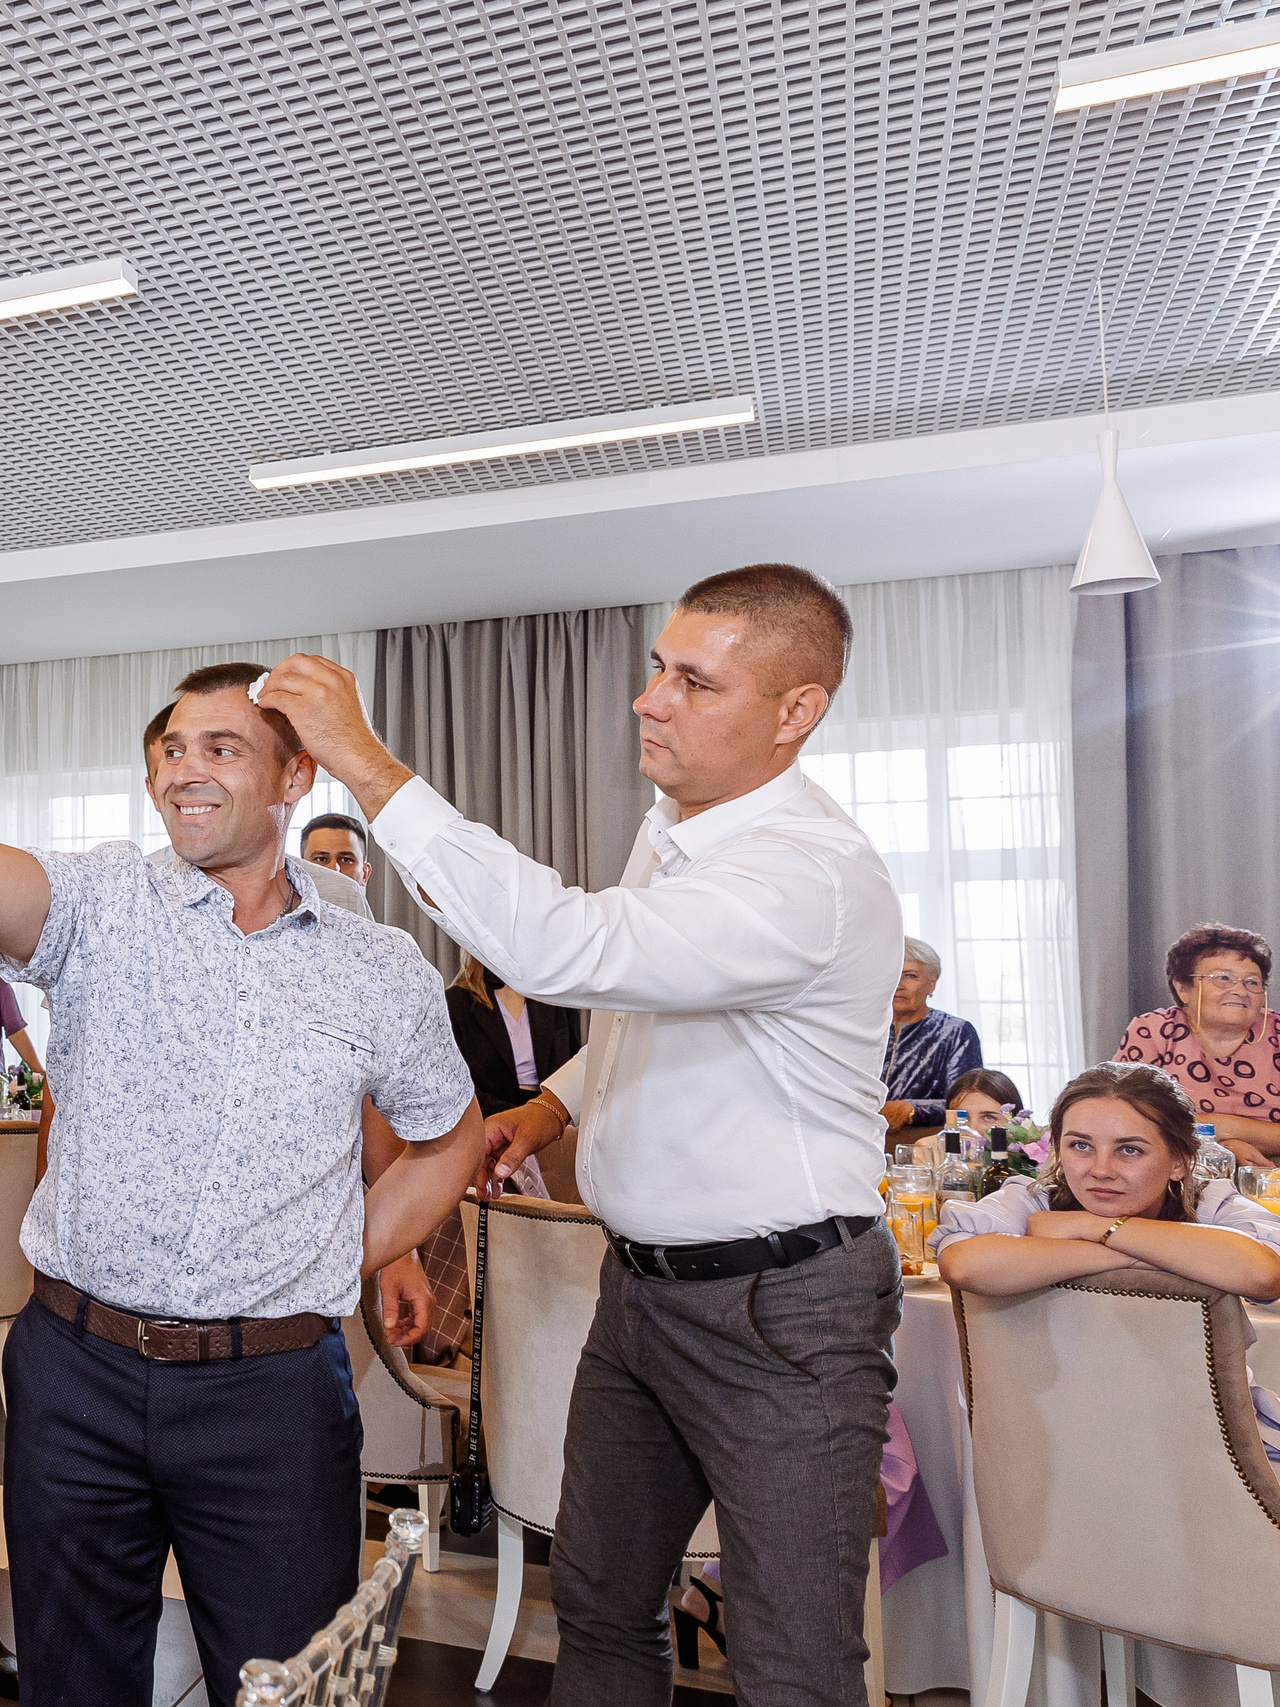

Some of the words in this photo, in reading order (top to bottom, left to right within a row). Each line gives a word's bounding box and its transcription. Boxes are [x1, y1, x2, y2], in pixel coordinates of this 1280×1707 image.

[478, 1208, 487, 1248] BETTER
[475, 1251, 485, 1299] FOREVER
[473, 1309, 482, 1350] BETTER
[471, 1352, 480, 1401] FOREVER
[469, 1410, 478, 1451] BETTER
